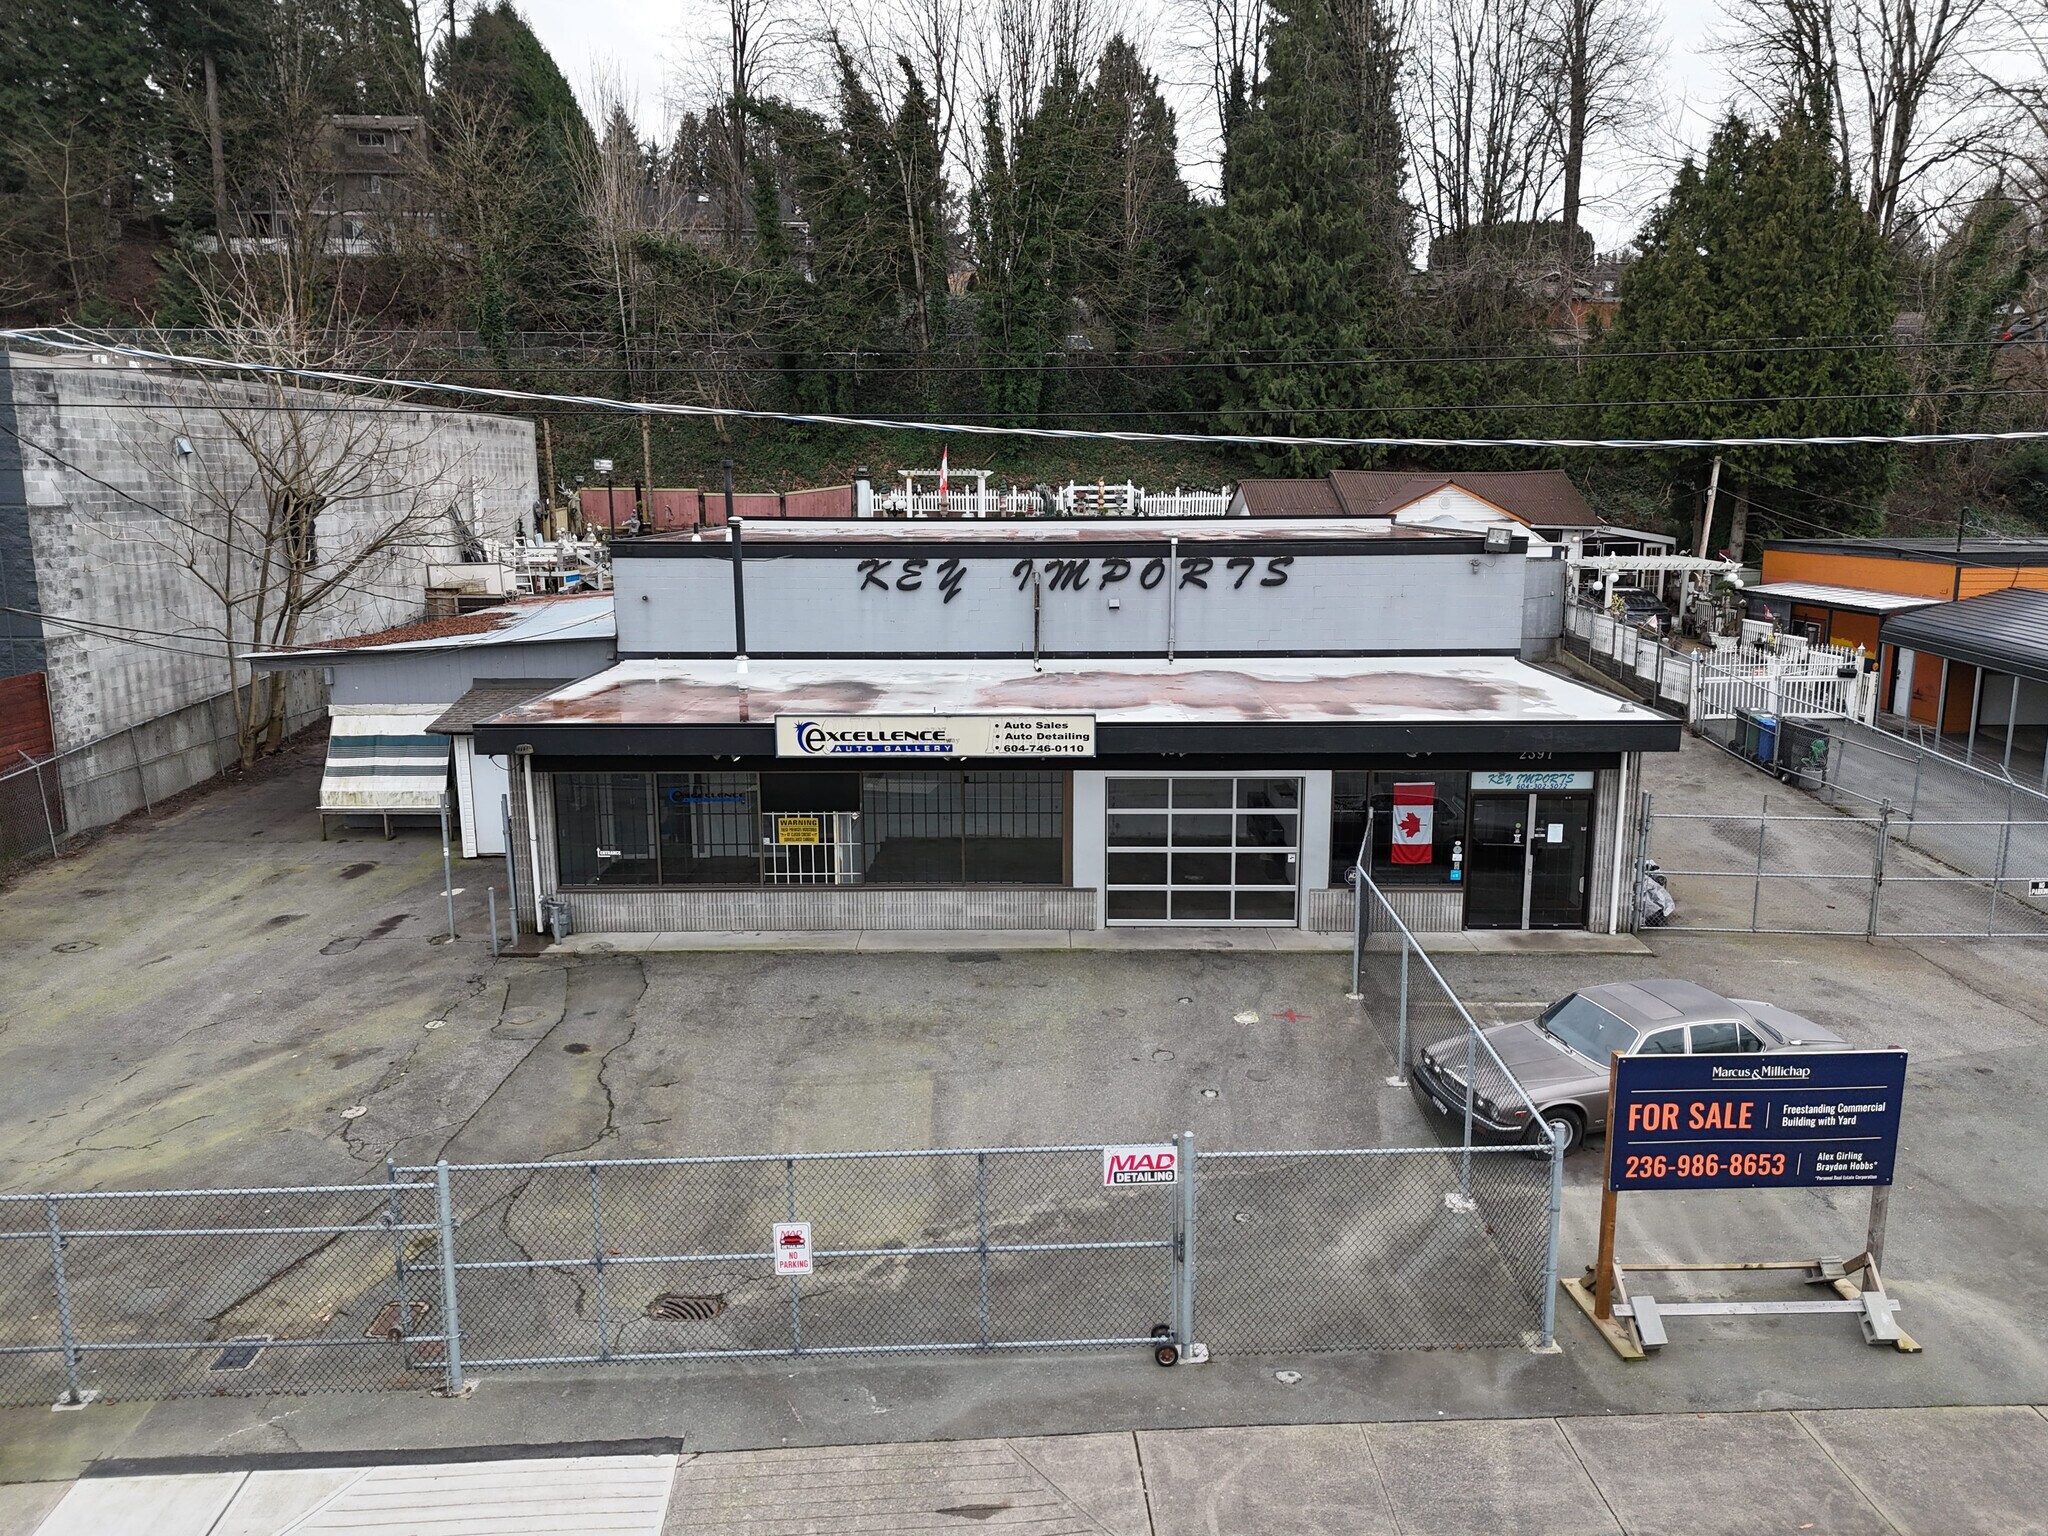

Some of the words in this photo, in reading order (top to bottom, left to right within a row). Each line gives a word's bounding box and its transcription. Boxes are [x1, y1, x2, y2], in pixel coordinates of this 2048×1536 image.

[857, 557, 967, 604] KEY
[1012, 555, 1295, 592] IMPORTS
[1003, 721, 1032, 730] Auto
[1035, 721, 1069, 730] Sales
[1004, 732, 1033, 741] Auto
[1036, 732, 1090, 742] Detailing
[1003, 744, 1085, 753] 604-746-0110
[1487, 773, 1514, 787] KEY
[1516, 773, 1575, 784] IMPORTS
[1712, 1066, 1751, 1078] Marcus
[1751, 1068, 1763, 1080] &
[1761, 1065, 1811, 1079] Millichap
[1783, 1103, 1836, 1115] Freestanding
[1837, 1101, 1887, 1113] Commercial
[1628, 1102, 1680, 1131] FOR
[1688, 1102, 1755, 1130] SALE
[1781, 1116, 1816, 1128] Building
[1817, 1116, 1836, 1127] with
[1837, 1115, 1857, 1126] Yard
[1817, 1152, 1834, 1161] Alex
[1836, 1151, 1863, 1162] Girling
[1106, 1153, 1176, 1184] MAD
[1625, 1153, 1786, 1178] 236-986-8653
[1816, 1161, 1848, 1173] Braydon
[1115, 1171, 1174, 1183] DETAILING
[788, 1251, 799, 1260] NO
[779, 1260, 809, 1269] PARKING
